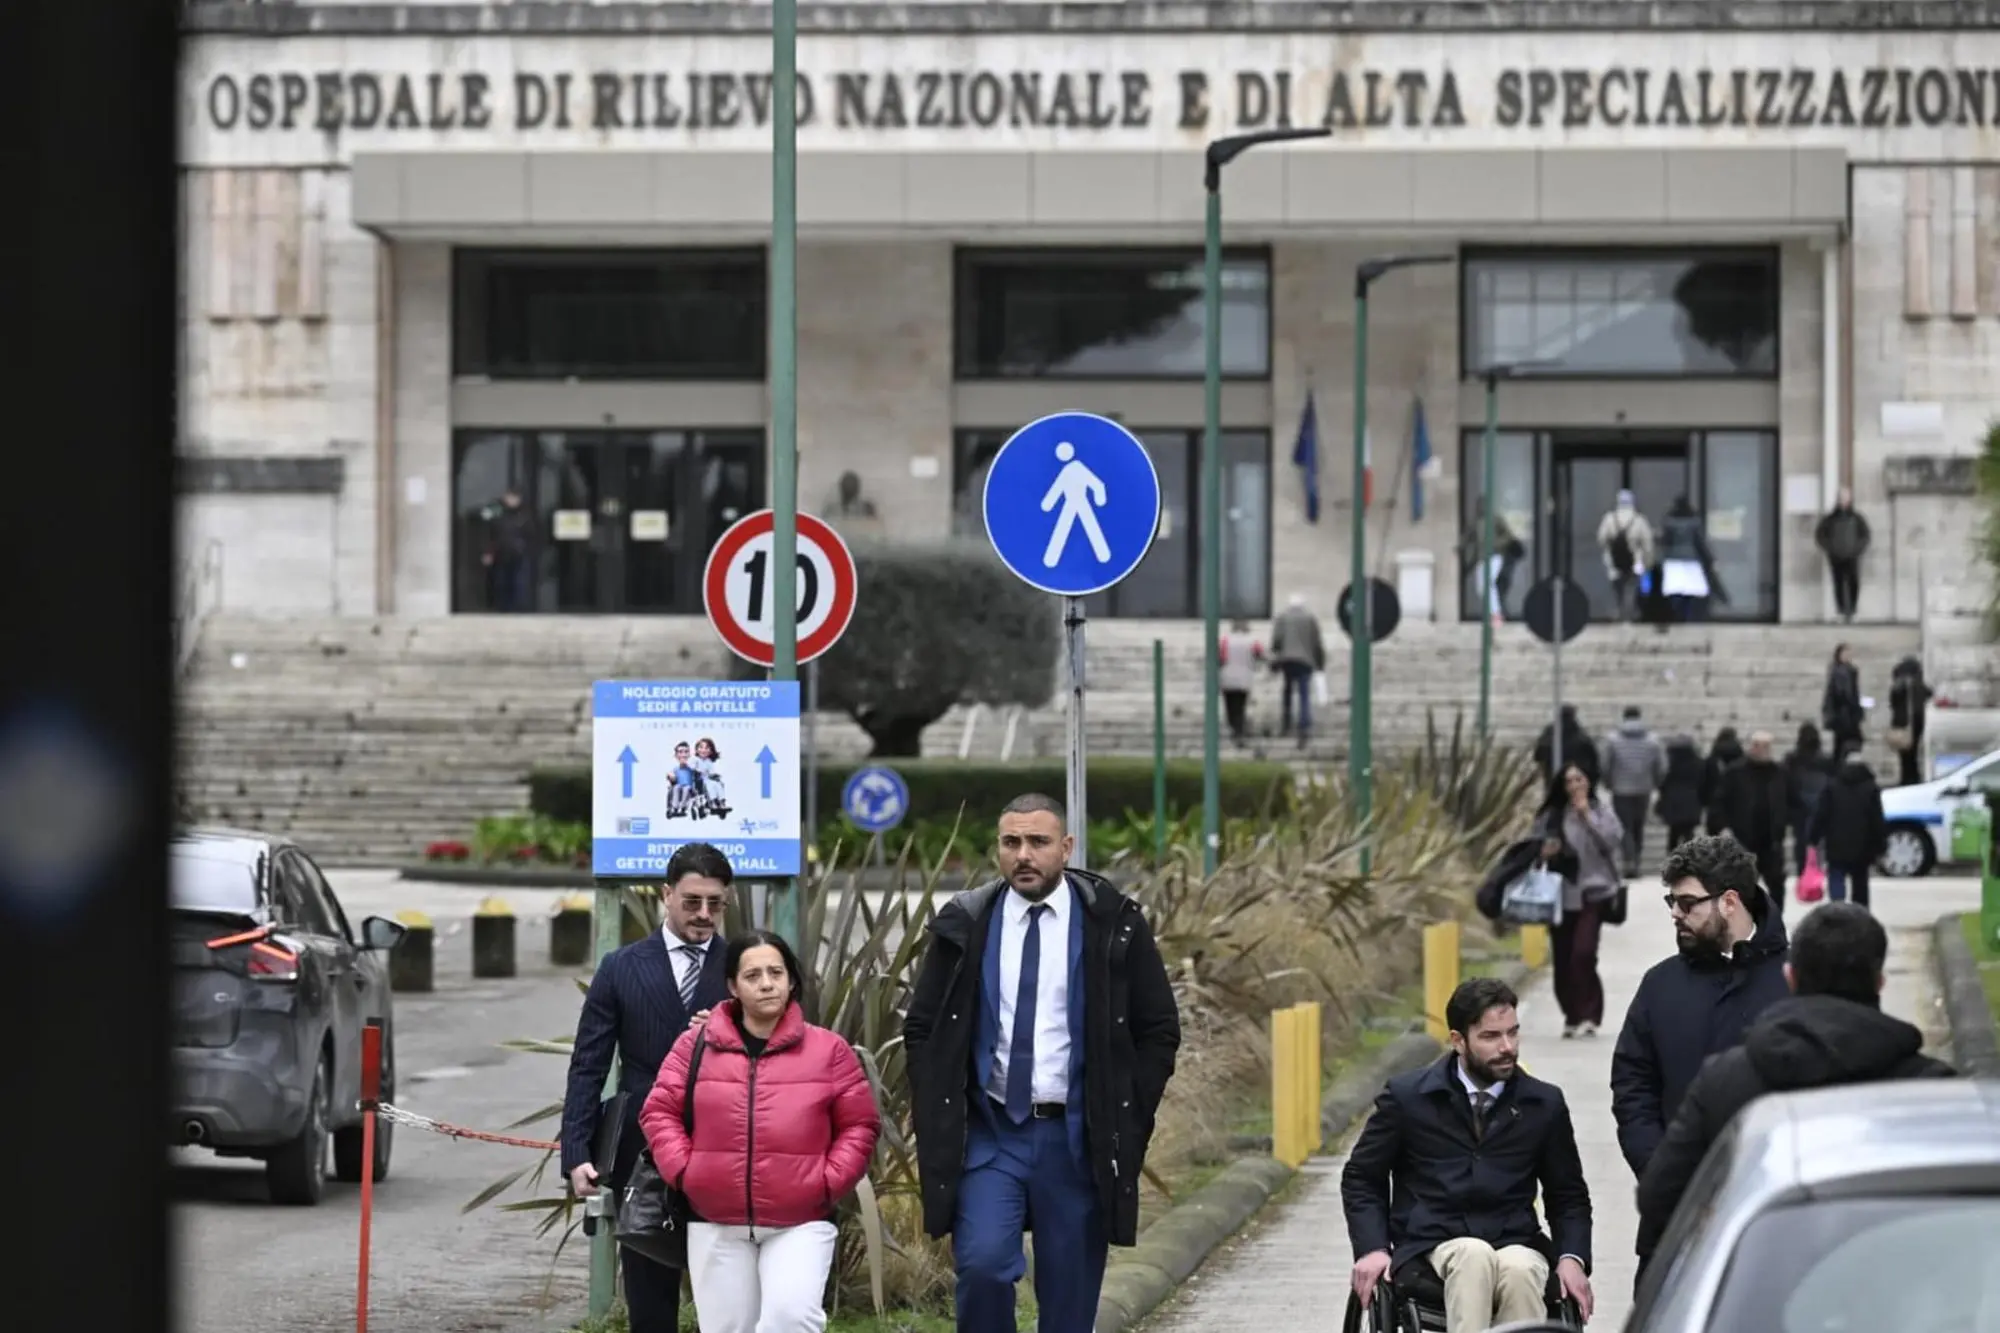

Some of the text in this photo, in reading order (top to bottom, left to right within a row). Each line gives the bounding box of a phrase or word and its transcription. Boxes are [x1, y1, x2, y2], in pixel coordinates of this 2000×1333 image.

[207, 68, 2000, 130] OSPEDALE DI RILIEVO NAZIONALE E DI ALTA SPECIALIZZAZION
[623, 686, 771, 699] NOLEGGIO GRATUITO
[638, 701, 756, 713] SEDIE A ROTELLE
[615, 857, 670, 870] GETTO
[738, 857, 778, 870] HALL
